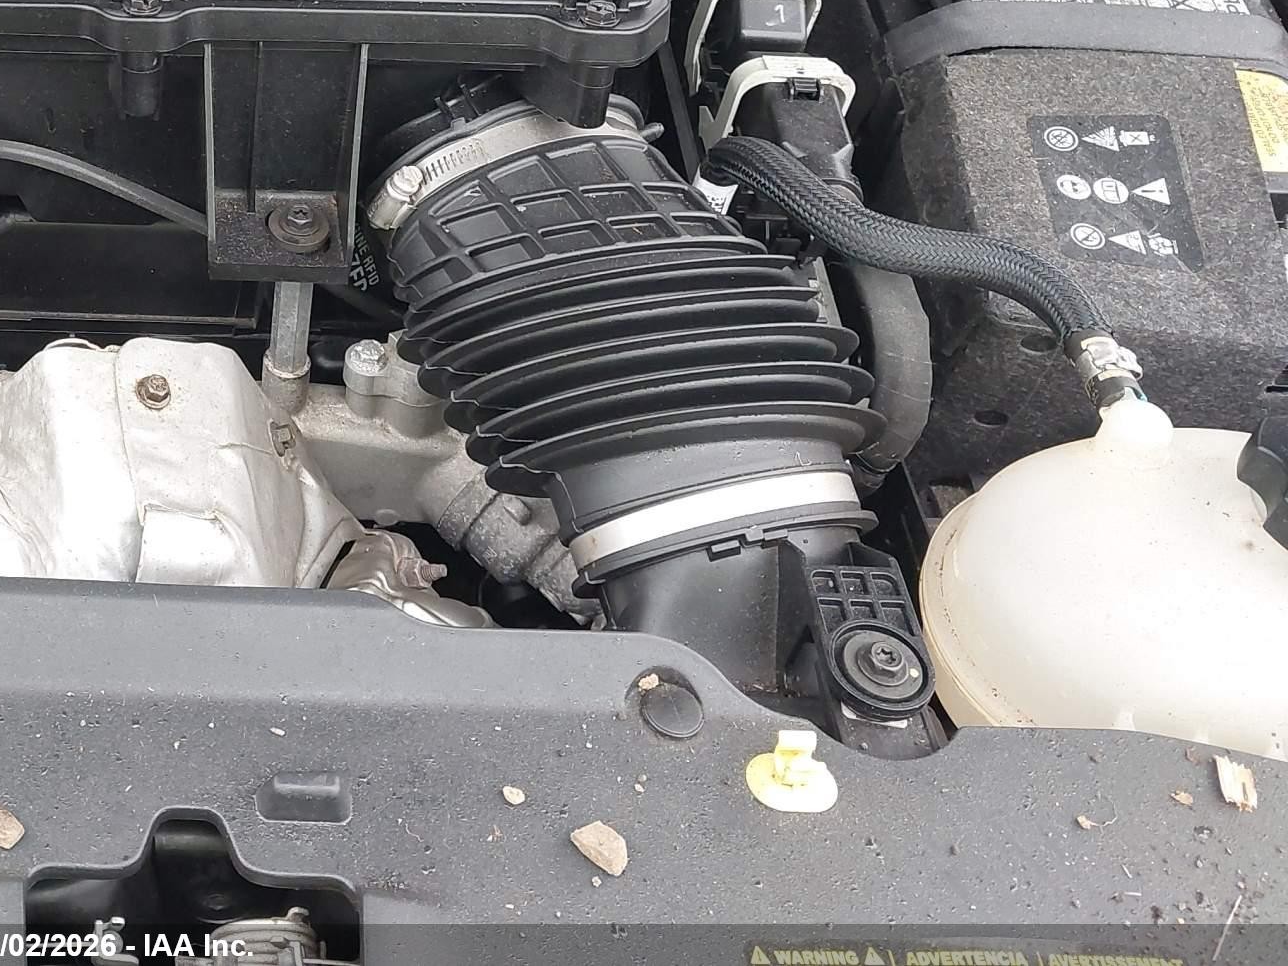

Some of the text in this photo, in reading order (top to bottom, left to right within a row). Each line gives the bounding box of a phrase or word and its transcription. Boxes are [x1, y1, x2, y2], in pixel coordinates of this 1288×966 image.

[362, 255, 380, 286] RFID
[773, 950, 859, 965] WARNING
[906, 950, 1029, 966] ADVERTENCIA
